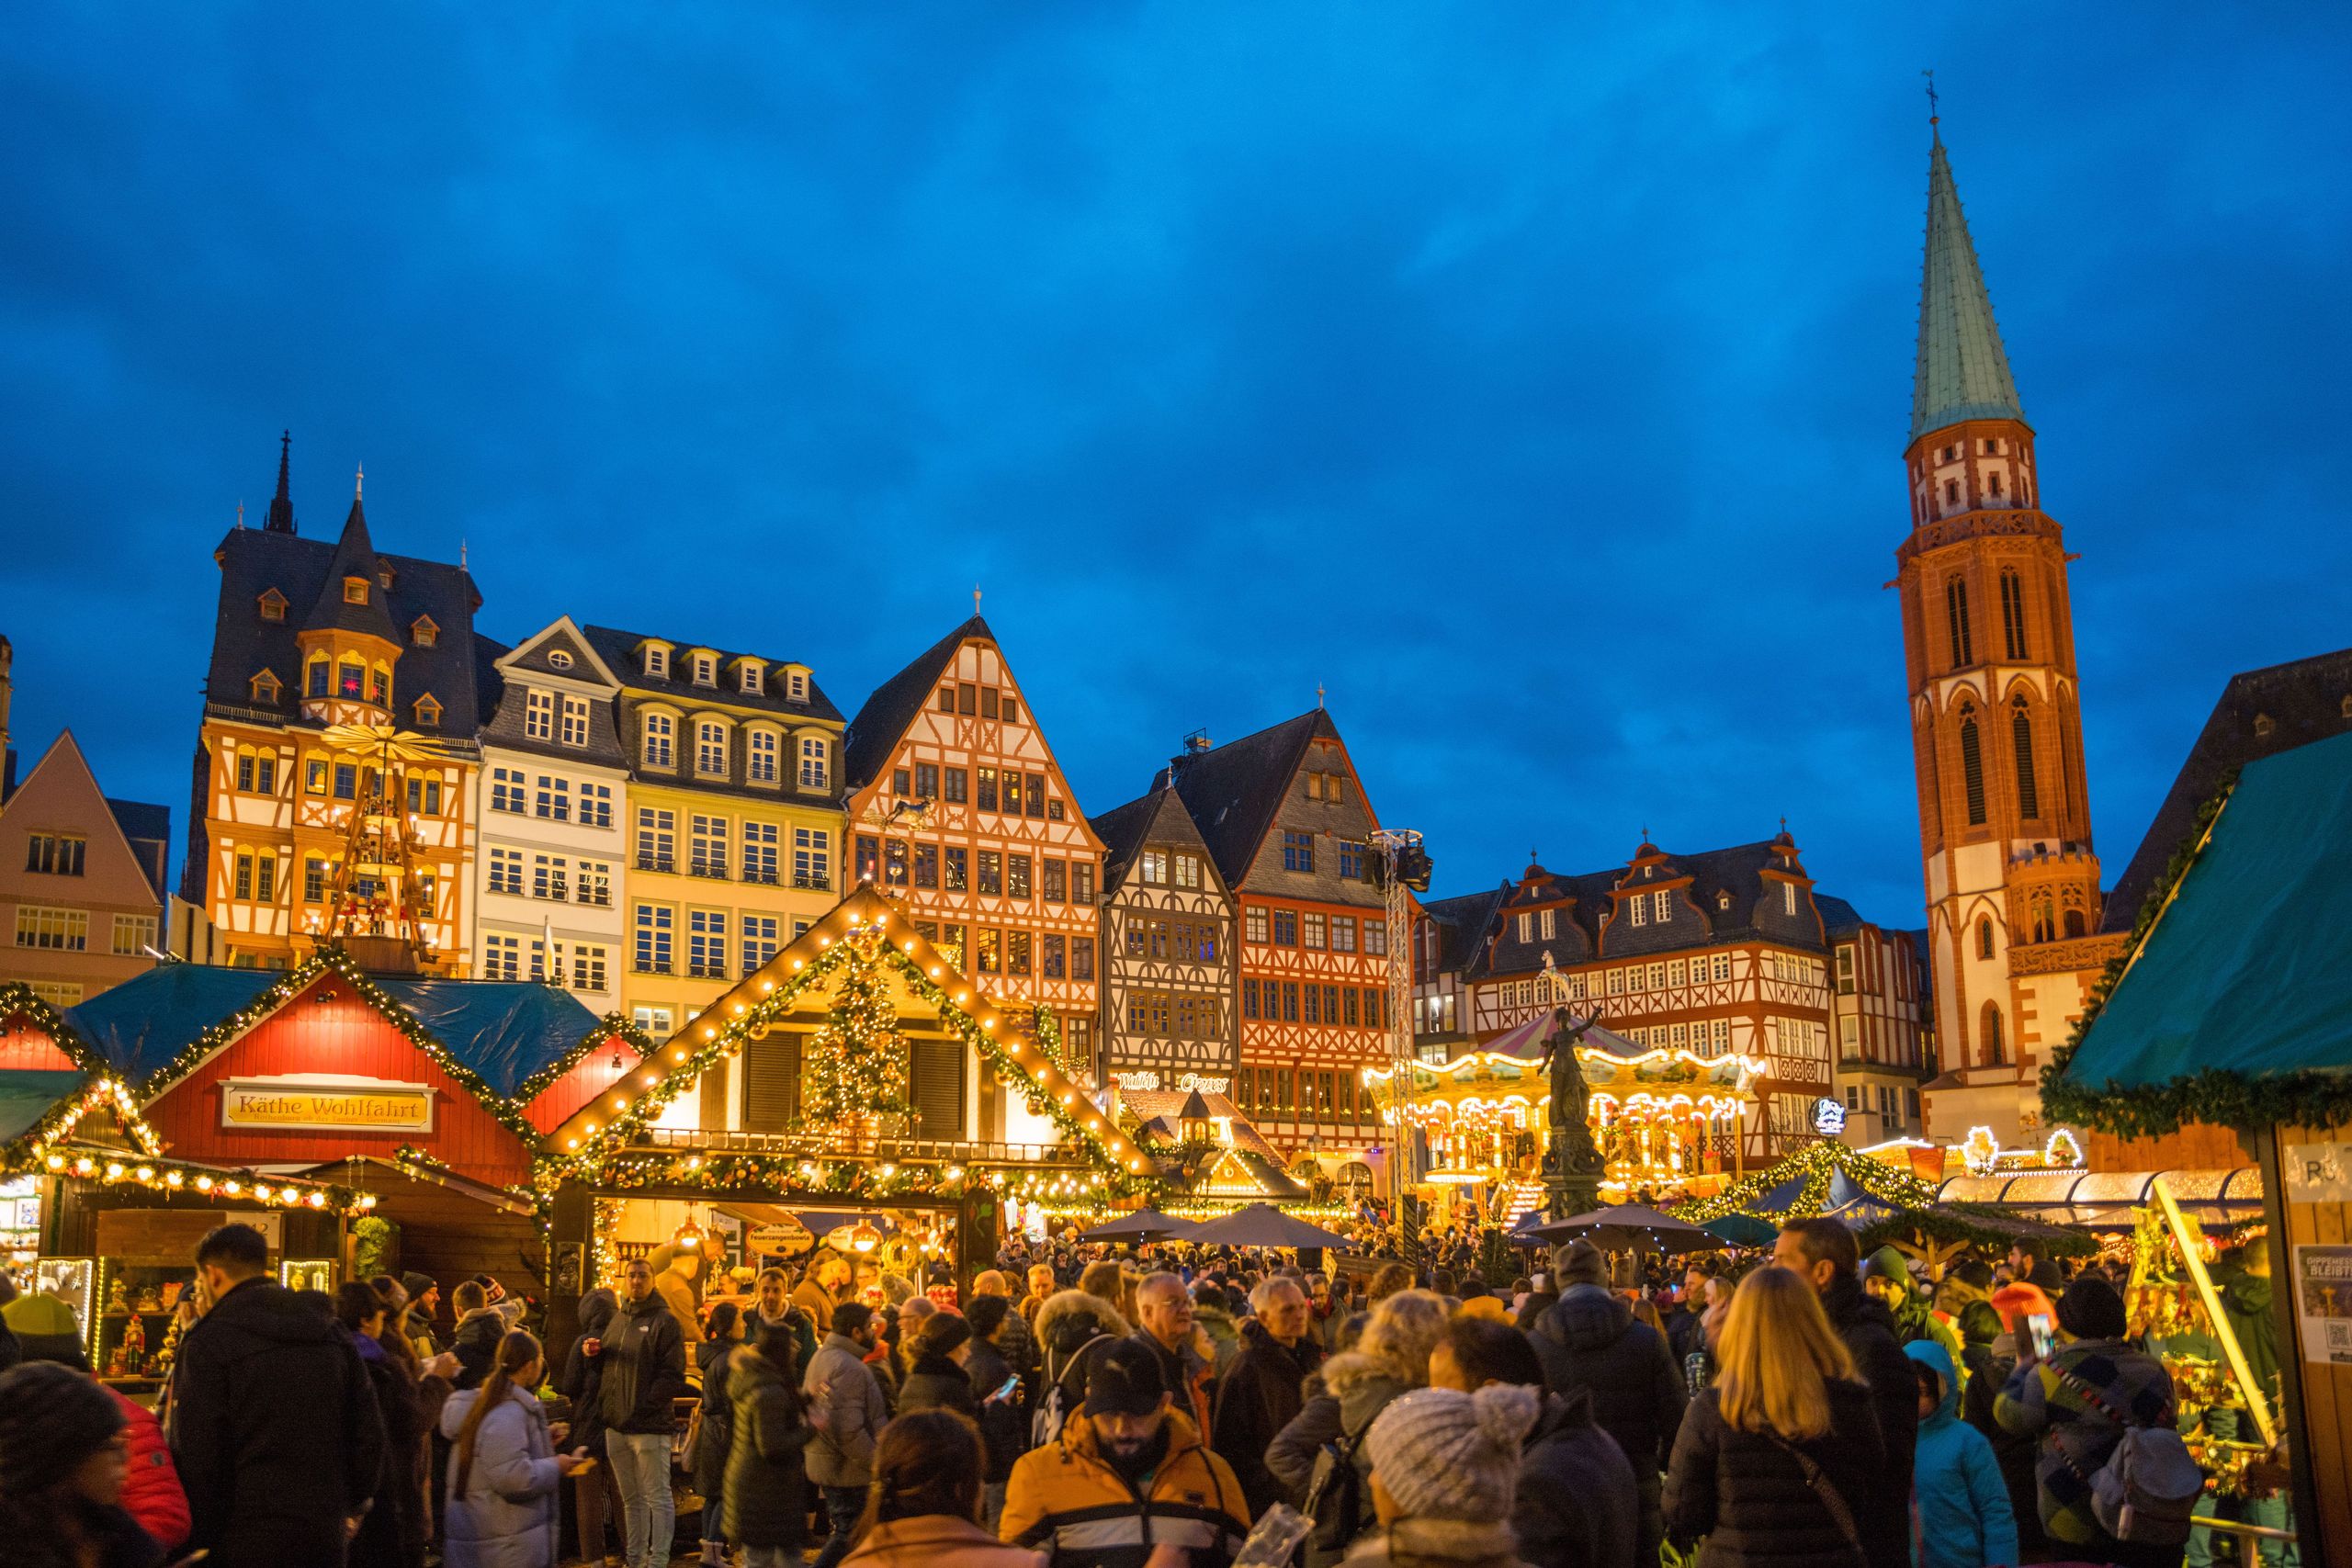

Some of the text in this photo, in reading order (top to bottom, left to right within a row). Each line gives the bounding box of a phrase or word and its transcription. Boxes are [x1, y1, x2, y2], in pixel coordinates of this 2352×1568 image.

[239, 1095, 419, 1118] Käthe Wohlfahrt
[750, 1234, 810, 1242] Feuerzangenbowle
